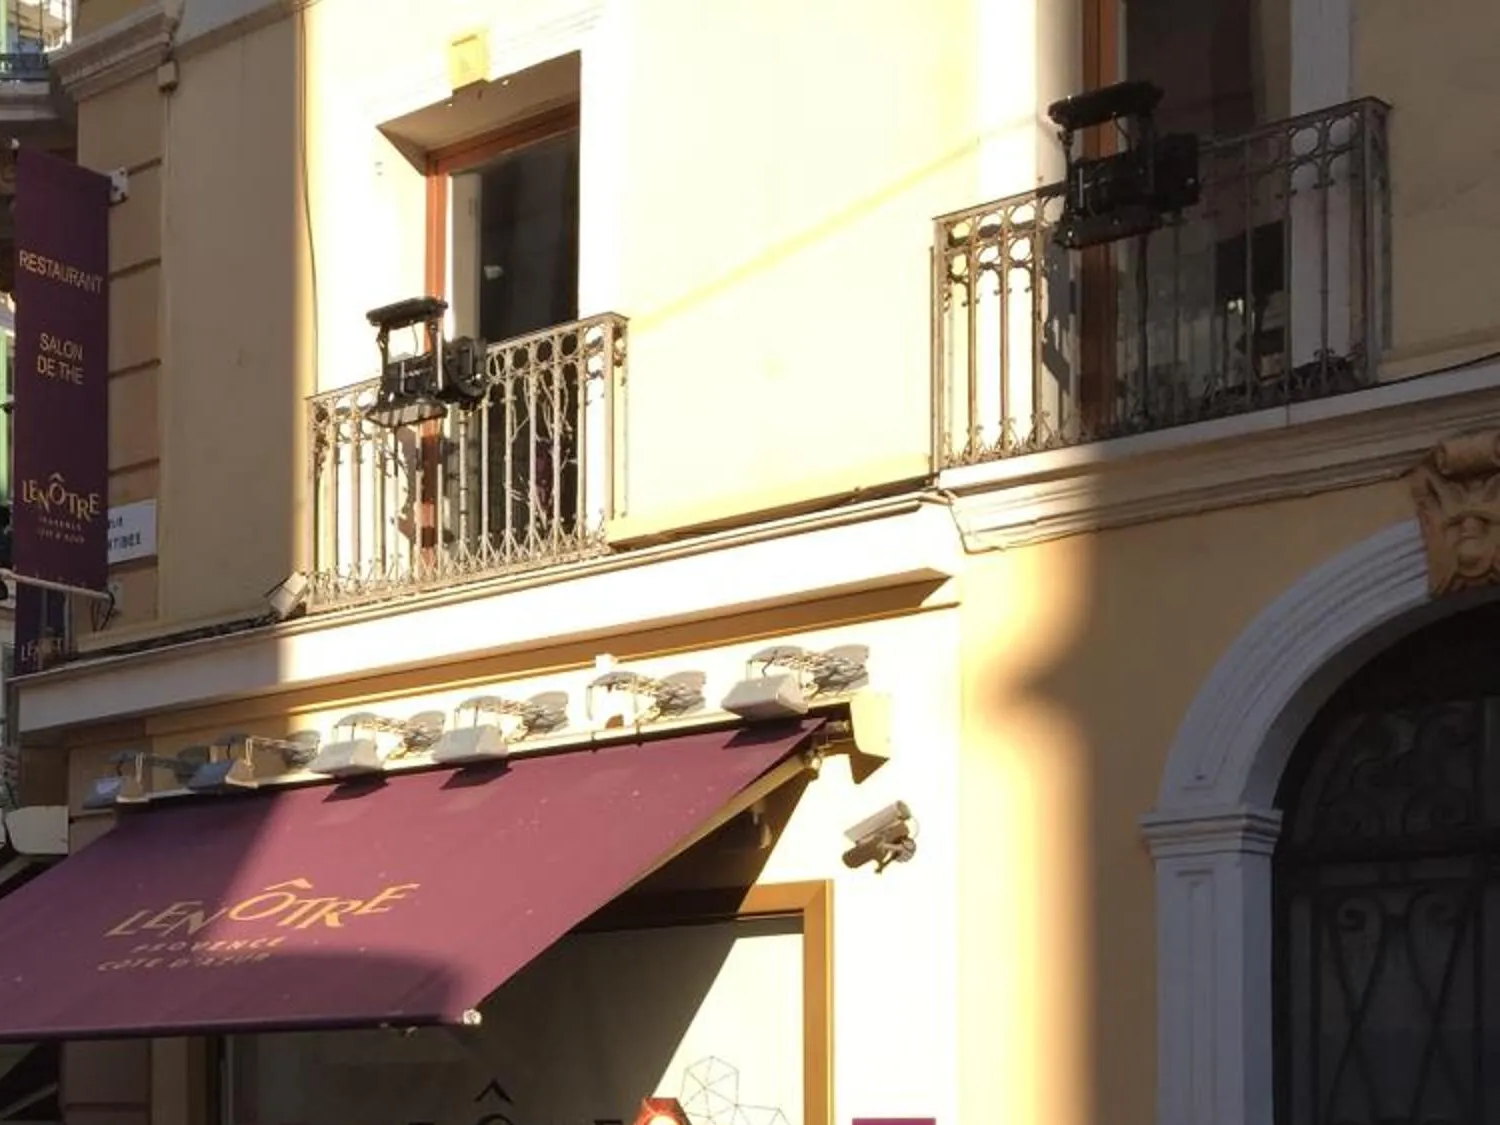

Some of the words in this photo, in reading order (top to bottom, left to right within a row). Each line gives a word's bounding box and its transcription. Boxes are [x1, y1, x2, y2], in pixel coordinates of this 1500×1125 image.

[19, 249, 104, 294] RESTAURANT
[39, 332, 83, 361] SALON
[37, 355, 56, 379] DE
[22, 472, 101, 522] LENÔTRE
[103, 878, 420, 938] LENÔTRE
[130, 937, 288, 954] PROVENCE
